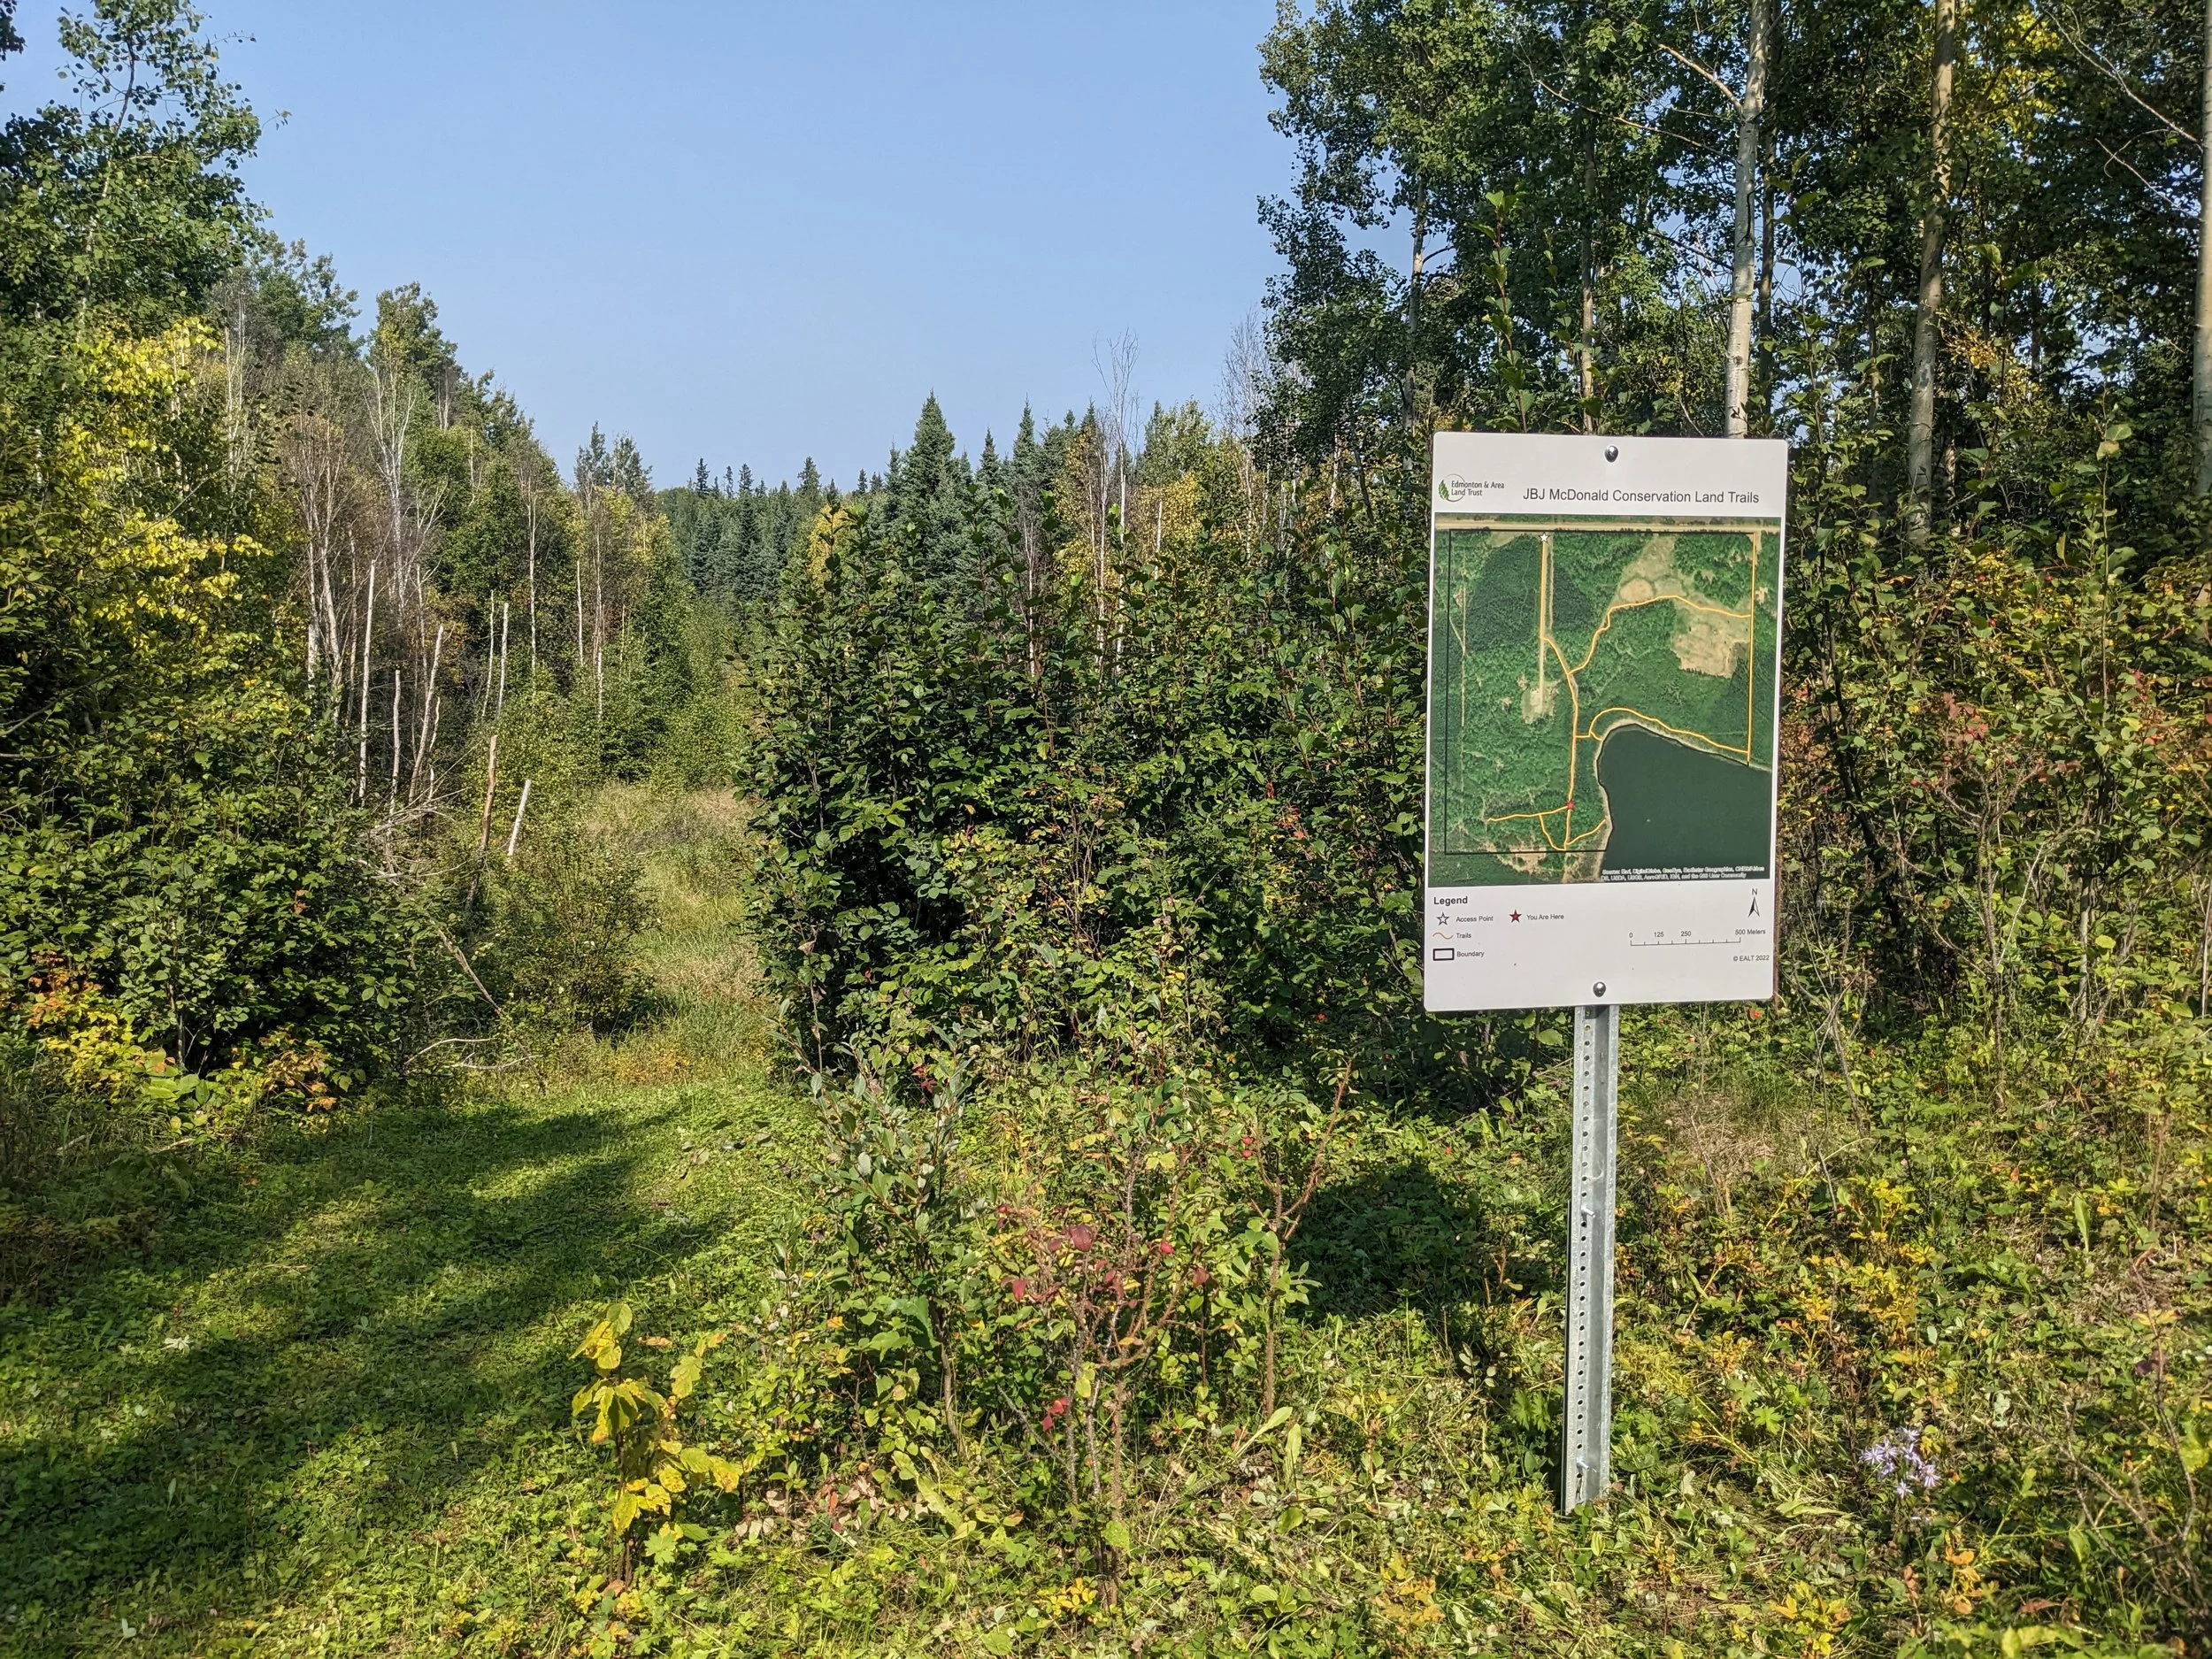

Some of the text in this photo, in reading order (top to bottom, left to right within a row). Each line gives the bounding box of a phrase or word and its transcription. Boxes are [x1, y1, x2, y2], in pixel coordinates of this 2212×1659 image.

[1523, 488, 1760, 503] JBJ McDonald Conservation Land Trails
[1433, 895, 1468, 906] Legend
